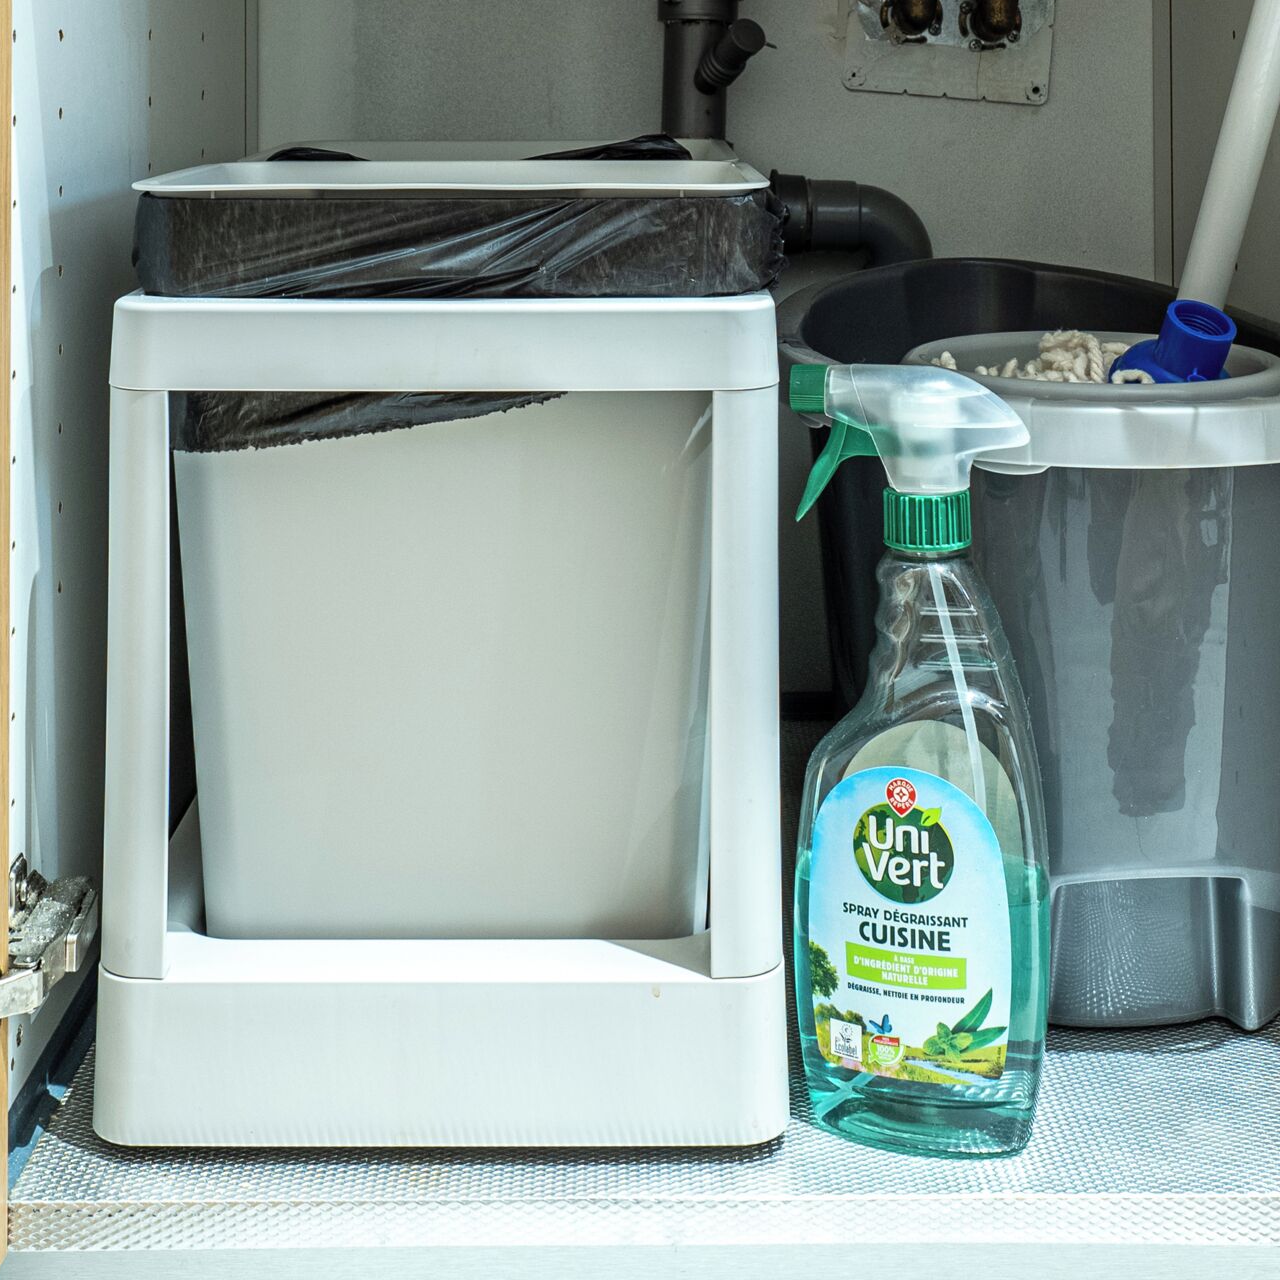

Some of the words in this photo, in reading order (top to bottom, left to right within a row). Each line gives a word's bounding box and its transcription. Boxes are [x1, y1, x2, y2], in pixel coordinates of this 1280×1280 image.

[868, 815, 929, 855] Uni
[862, 841, 945, 889] Vert
[843, 902, 879, 919] SPRAY
[883, 909, 968, 928] DÉGRAISSANT
[859, 921, 951, 952] CUISINE
[881, 971, 928, 986] NATURELLE
[913, 965, 959, 978] D'ORIGINE
[847, 981, 882, 996] DÉGRAISSE,
[883, 989, 908, 1000] NETTOIE
[910, 993, 919, 1001] EN
[920, 994, 965, 1004] PROFONDEUR
